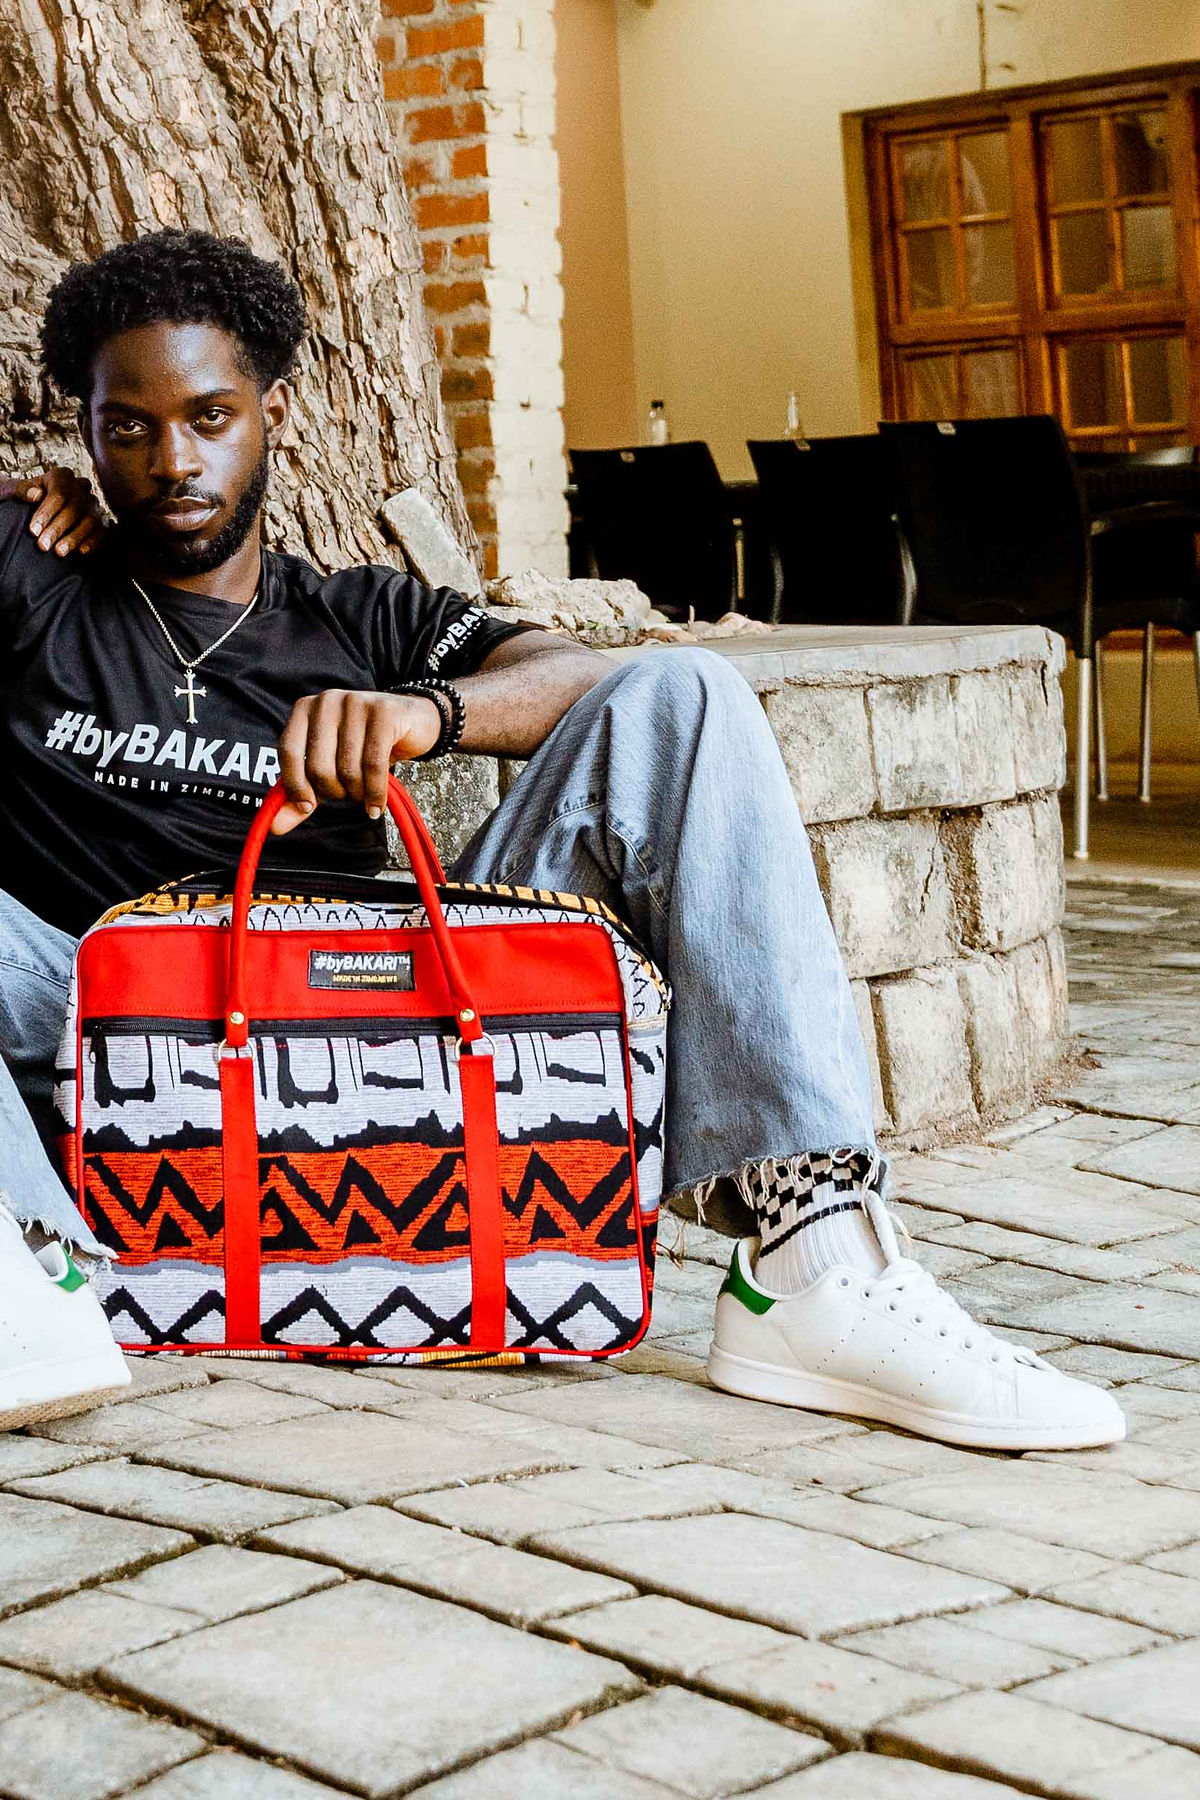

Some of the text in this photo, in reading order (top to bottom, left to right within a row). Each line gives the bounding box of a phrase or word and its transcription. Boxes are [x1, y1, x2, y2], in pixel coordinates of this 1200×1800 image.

[45, 710, 282, 788] #byBAKAR
[94, 771, 264, 809] MADE IN ZIMBABW
